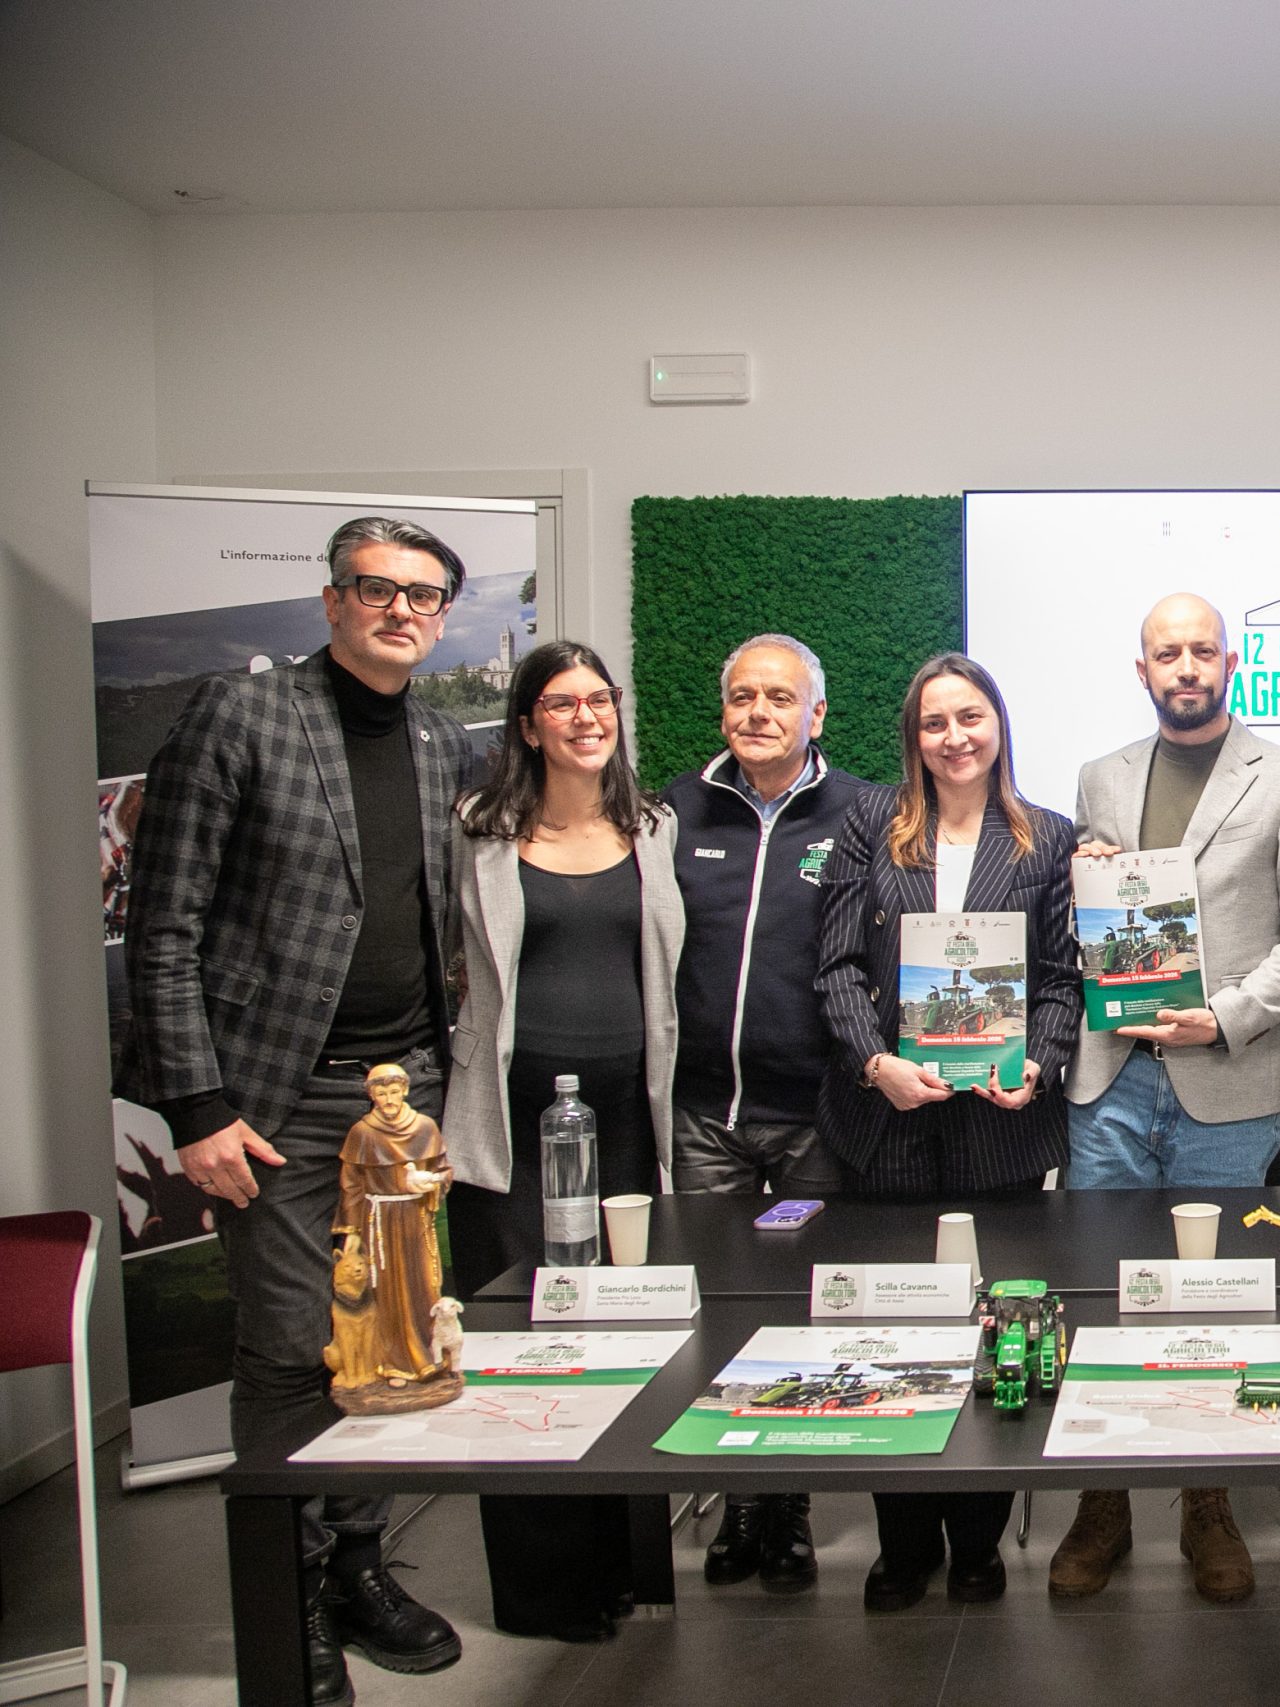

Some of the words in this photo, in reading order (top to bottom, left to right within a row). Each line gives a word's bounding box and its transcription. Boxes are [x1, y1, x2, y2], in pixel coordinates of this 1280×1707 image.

[220, 550, 312, 562] L'informazione
[1243, 633, 1265, 665] 12
[798, 857, 827, 870] AGRIC
[1102, 976, 1132, 984] Domenica
[875, 1282, 898, 1291] Scilla
[899, 1283, 938, 1291] Cavanna
[1181, 1278, 1214, 1287] Alessio
[1215, 1277, 1260, 1287] Castellani
[597, 1285, 639, 1294] Giancarlo
[641, 1284, 687, 1293] Bordichini
